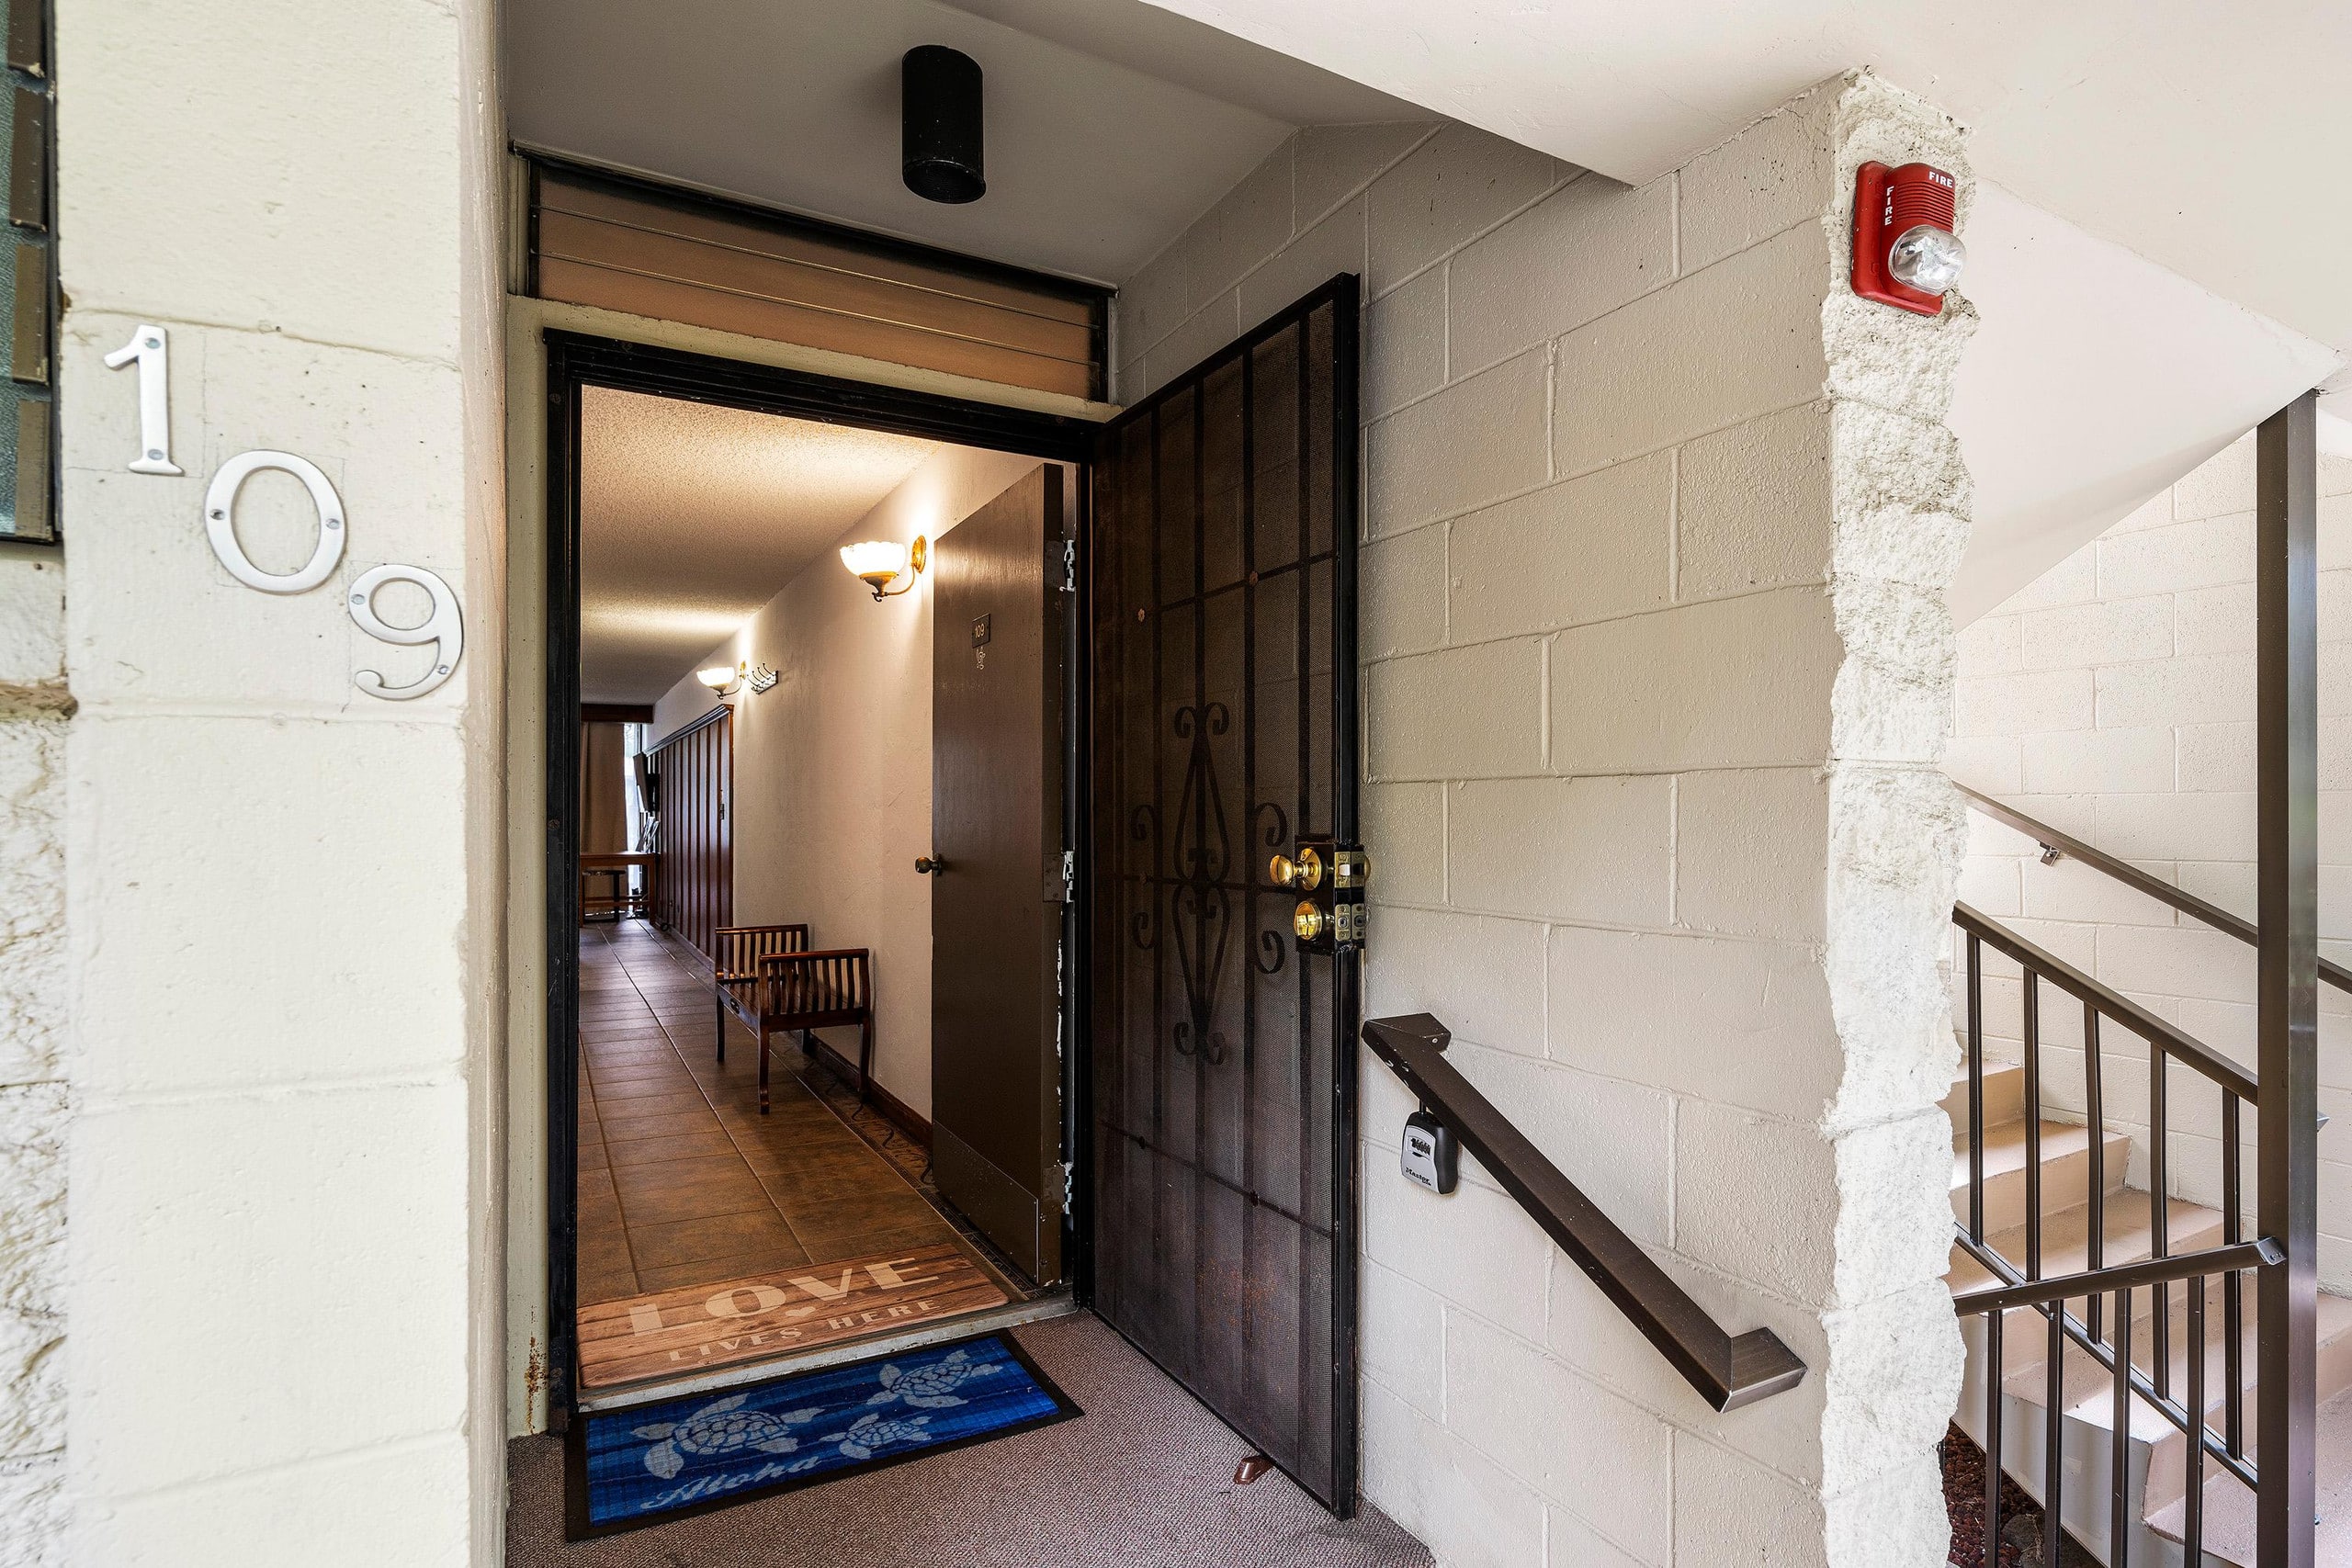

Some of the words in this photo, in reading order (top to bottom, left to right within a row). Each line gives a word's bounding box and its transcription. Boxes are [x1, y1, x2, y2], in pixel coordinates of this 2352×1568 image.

[1884, 186, 1895, 226] FIRE
[1929, 171, 1953, 188] FIRE
[104, 324, 464, 701] 109
[975, 623, 985, 638] 109
[628, 1257, 941, 1337] LOVE
[669, 1325, 803, 1362] LIVES
[827, 1299, 942, 1331] HERE
[639, 1455, 822, 1509] Aloha
